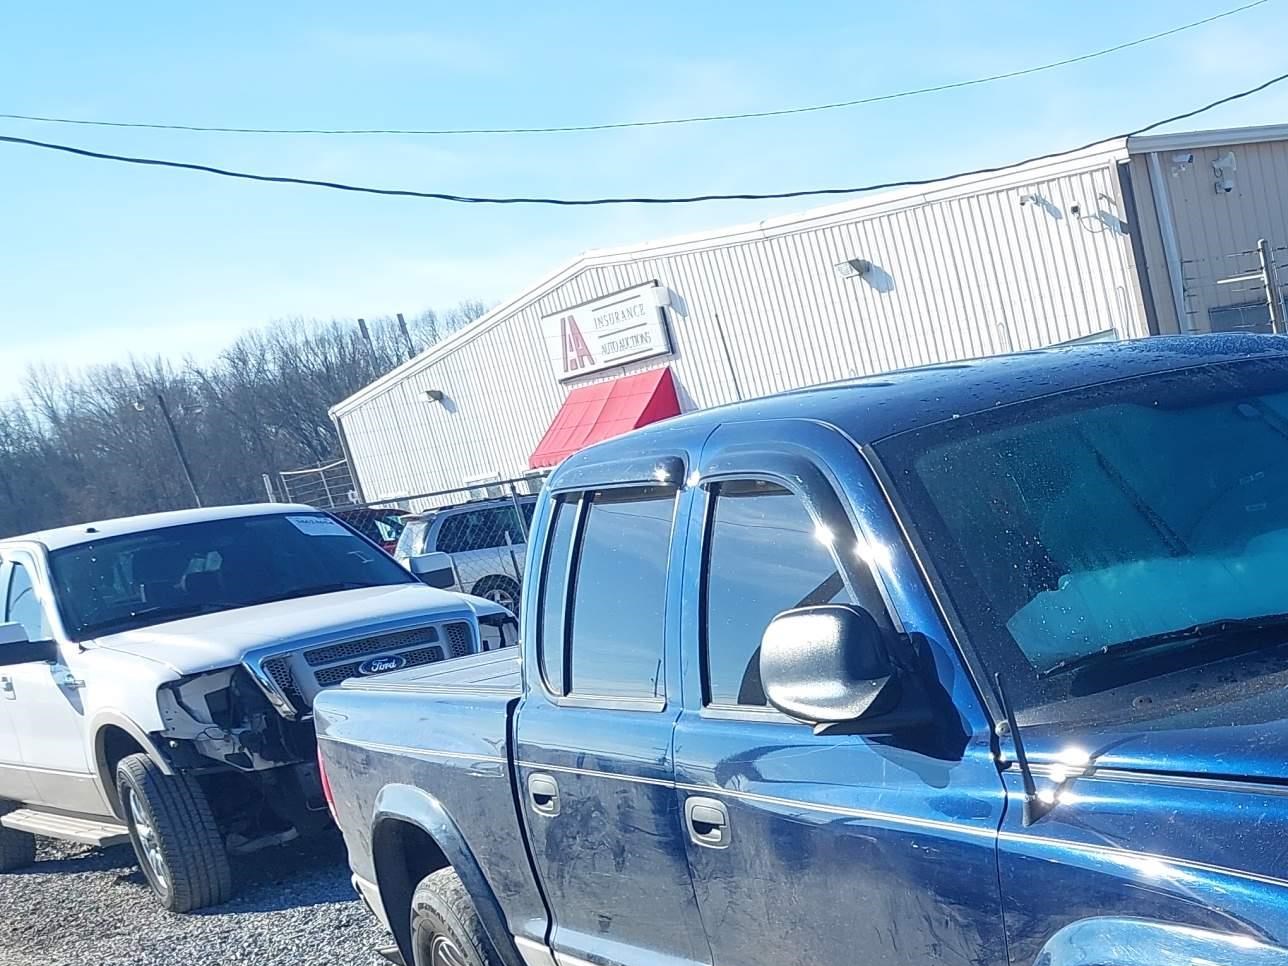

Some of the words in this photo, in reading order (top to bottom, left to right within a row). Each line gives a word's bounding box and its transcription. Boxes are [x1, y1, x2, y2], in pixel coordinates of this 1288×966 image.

[593, 303, 645, 329] INSURANCE
[601, 340, 619, 356] AUTO
[618, 331, 652, 352] AUCTIONS
[371, 659, 397, 671] Ford
